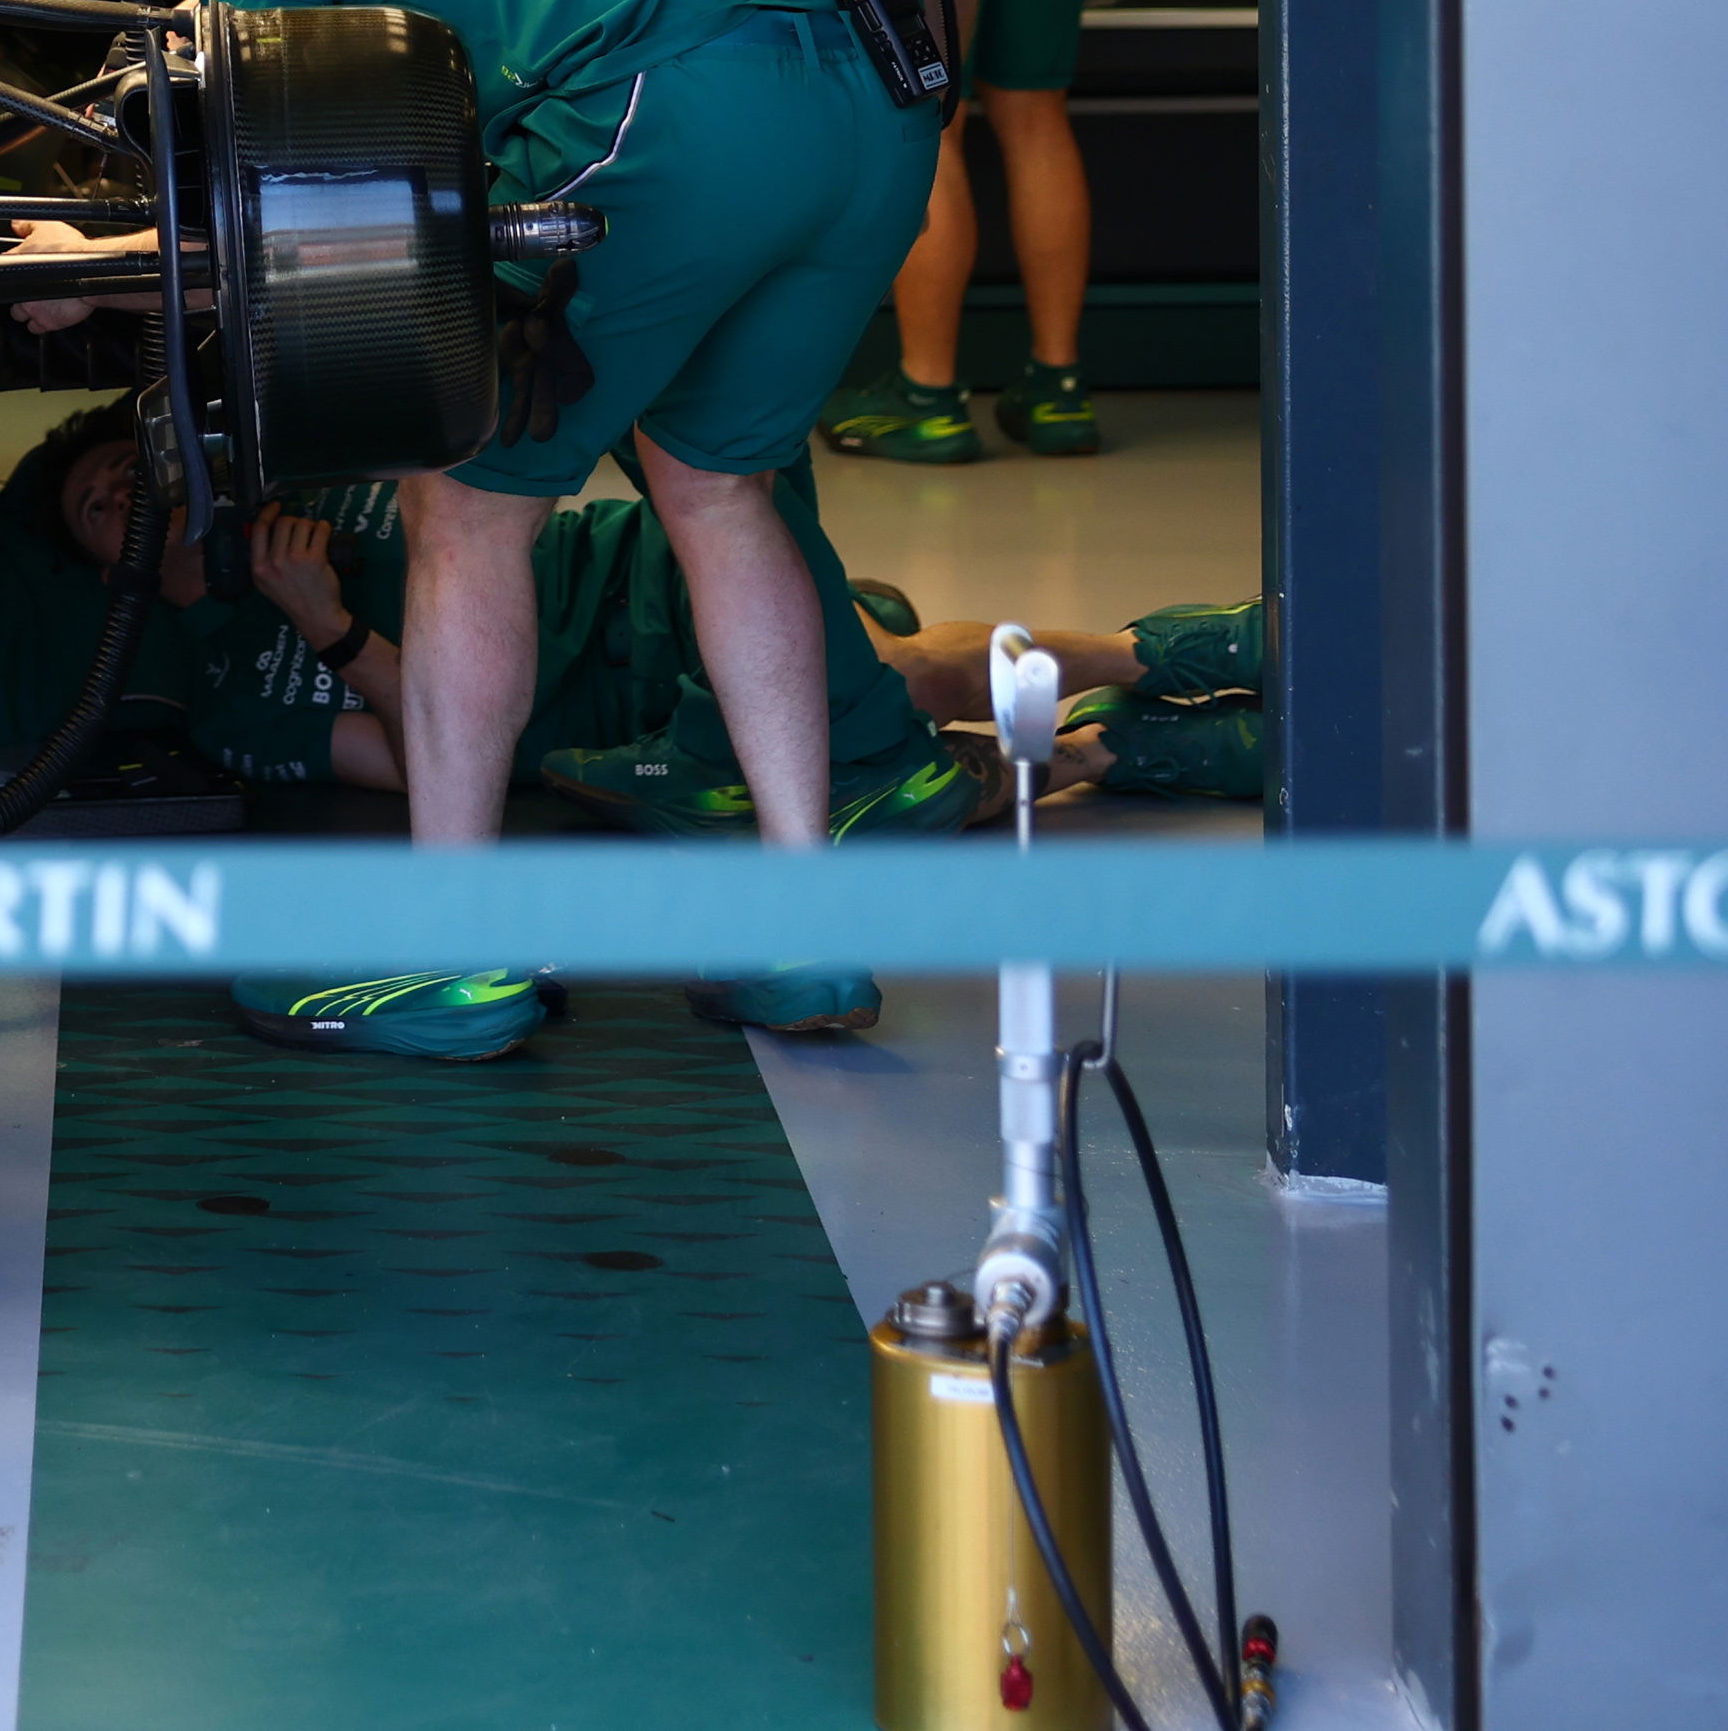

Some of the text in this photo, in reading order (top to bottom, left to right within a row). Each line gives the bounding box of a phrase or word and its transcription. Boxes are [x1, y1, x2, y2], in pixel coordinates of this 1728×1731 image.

[311, 661, 333, 704] BO
[634, 763, 670, 777] BOSS
[1475, 847, 1728, 962] AST
[310, 1019, 346, 1031] NITRO
